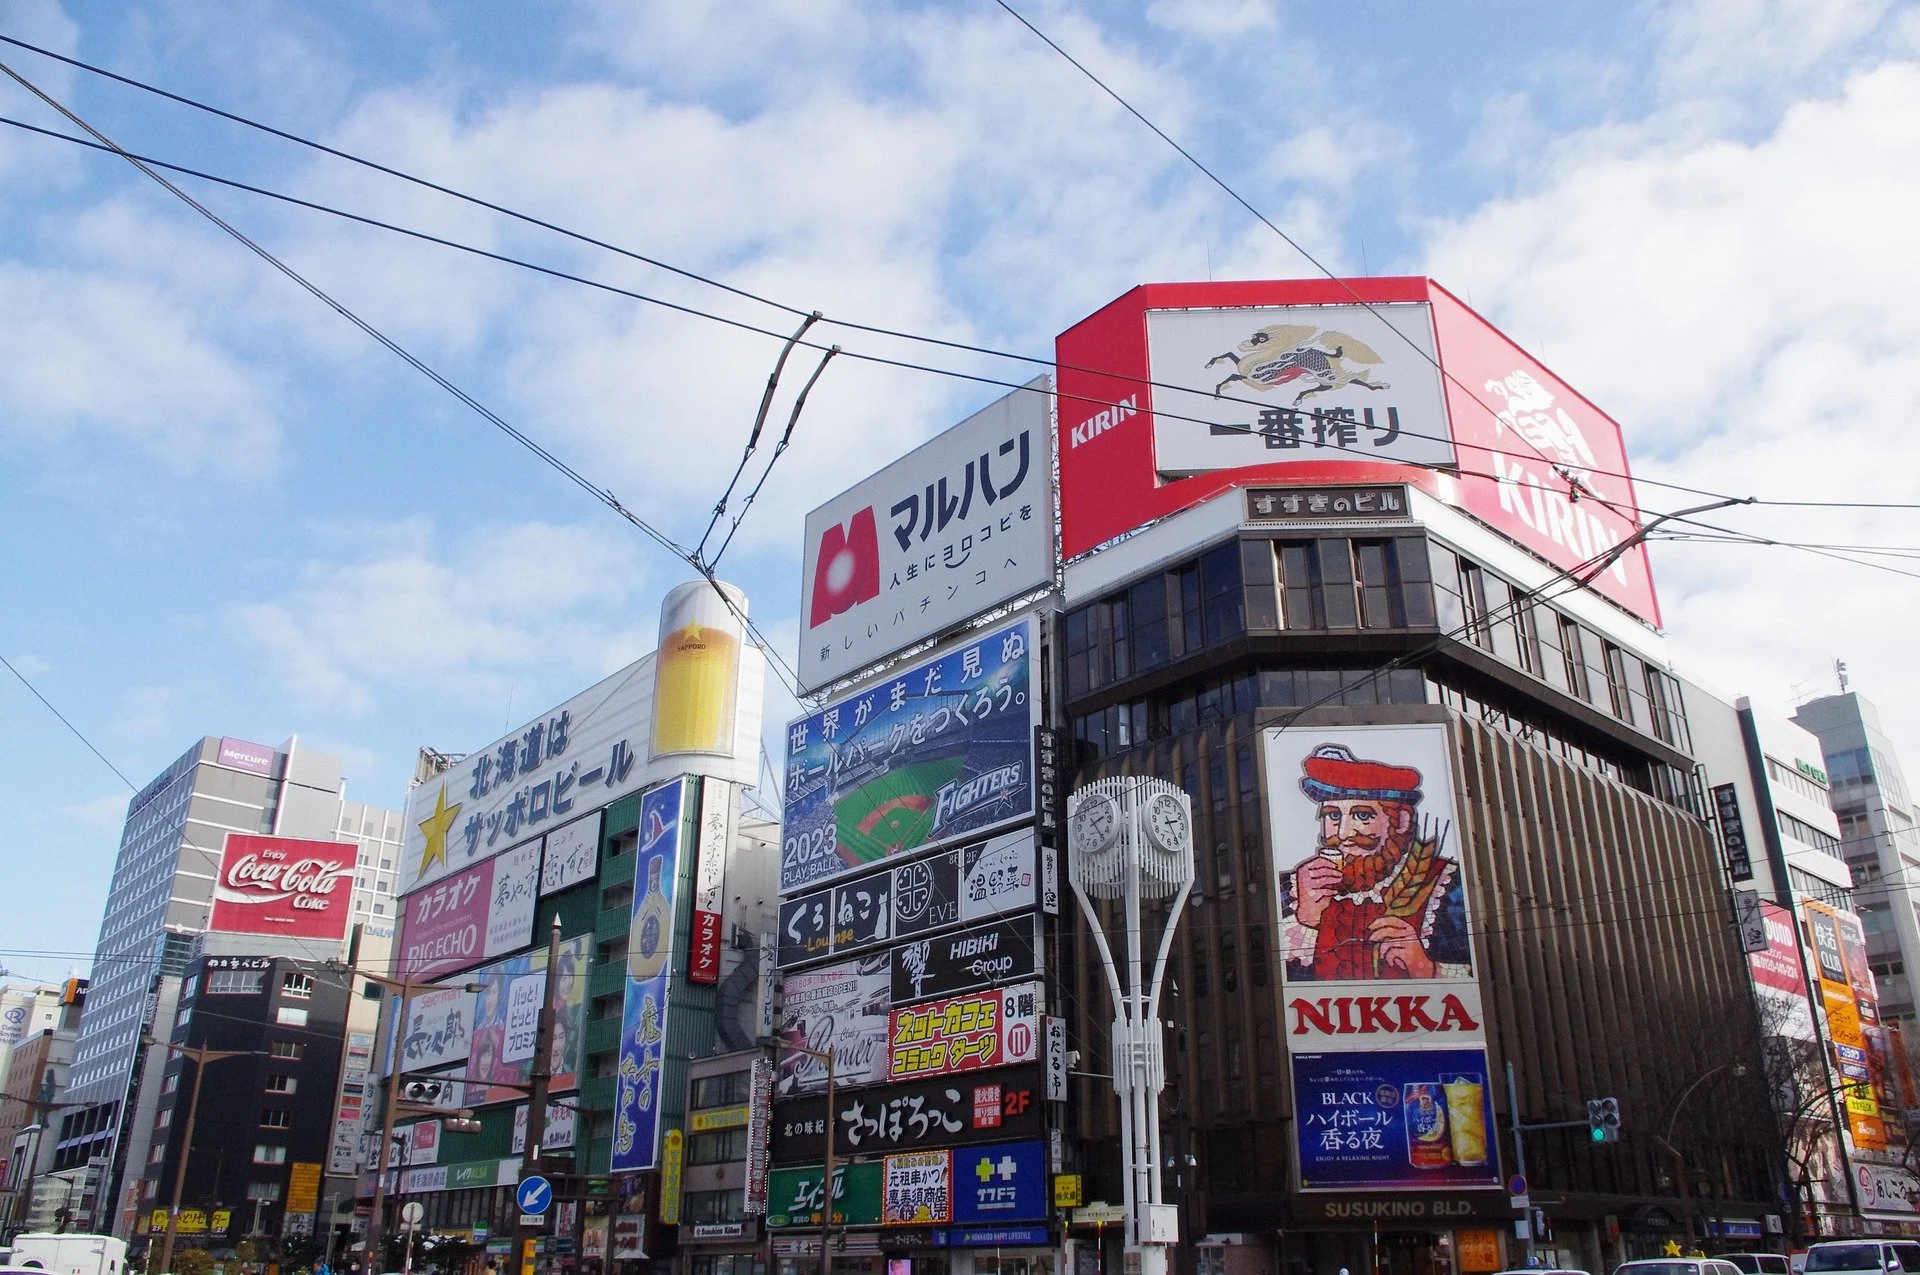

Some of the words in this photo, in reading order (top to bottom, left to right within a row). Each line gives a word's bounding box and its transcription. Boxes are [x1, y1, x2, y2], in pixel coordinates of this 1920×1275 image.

[1070, 394, 1137, 450] KIRIN
[1209, 406, 1400, 450] 一番搾り
[890, 429, 1030, 553] マルハン
[1253, 490, 1400, 515] すすきのビル
[1491, 447, 1628, 588] KIRIN
[889, 504, 1032, 590] 人生にヨロコビを
[677, 643, 707, 652] SAPPORO
[790, 631, 1024, 755] 世界がまだ見ぬ
[789, 675, 1026, 792] ボールパークをつくろう。
[223, 749, 269, 766] Mercure
[469, 709, 572, 800] 北海道は
[464, 738, 636, 857] サッポロビール
[928, 760, 1027, 838] FIGHTERS
[262, 850, 287, 860] Enjoy
[783, 824, 838, 869] 2023
[966, 850, 977, 863] 2F
[227, 854, 343, 894] Coca-Cola
[783, 867, 806, 885] PLAY
[809, 862, 836, 878] BALL
[968, 865, 1019, 901] 温野菜
[293, 894, 330, 911] Coke
[415, 874, 481, 925] カラオケ
[928, 900, 959, 926] EVE
[788, 890, 872, 945] くろねこ
[1763, 917, 1794, 948] OUND
[406, 940, 434, 973] BIG
[435, 923, 477, 958] ECHO
[699, 914, 715, 969] カラオケ
[950, 933, 999, 960] HIBIKI
[1813, 920, 1838, 951] 快活
[971, 956, 1013, 977] Group
[1820, 950, 1842, 973] CLUB
[1004, 992, 1034, 1018] 8階
[1288, 993, 1480, 1036] NIKKA
[403, 1008, 466, 1060] 長次郎
[894, 999, 998, 1045] ネットカフェ
[508, 1030, 536, 1053] プロミス
[950, 1034, 997, 1067] ダーツ
[891, 1043, 948, 1076] コミック
[1004, 1090, 1031, 1117] 2F
[1321, 1092, 1375, 1105] BLACK
[840, 1089, 964, 1145] さっぽろっこ
[1305, 1109, 1393, 1128] ハイボール
[1319, 1127, 1385, 1151] 香る夜
[889, 1169, 940, 1187] 元祖串かつ
[888, 1185, 947, 1205] 恵美須商店
[1324, 1200, 1426, 1218] SUSUKINO
[1432, 1200, 1477, 1216] BLD.
